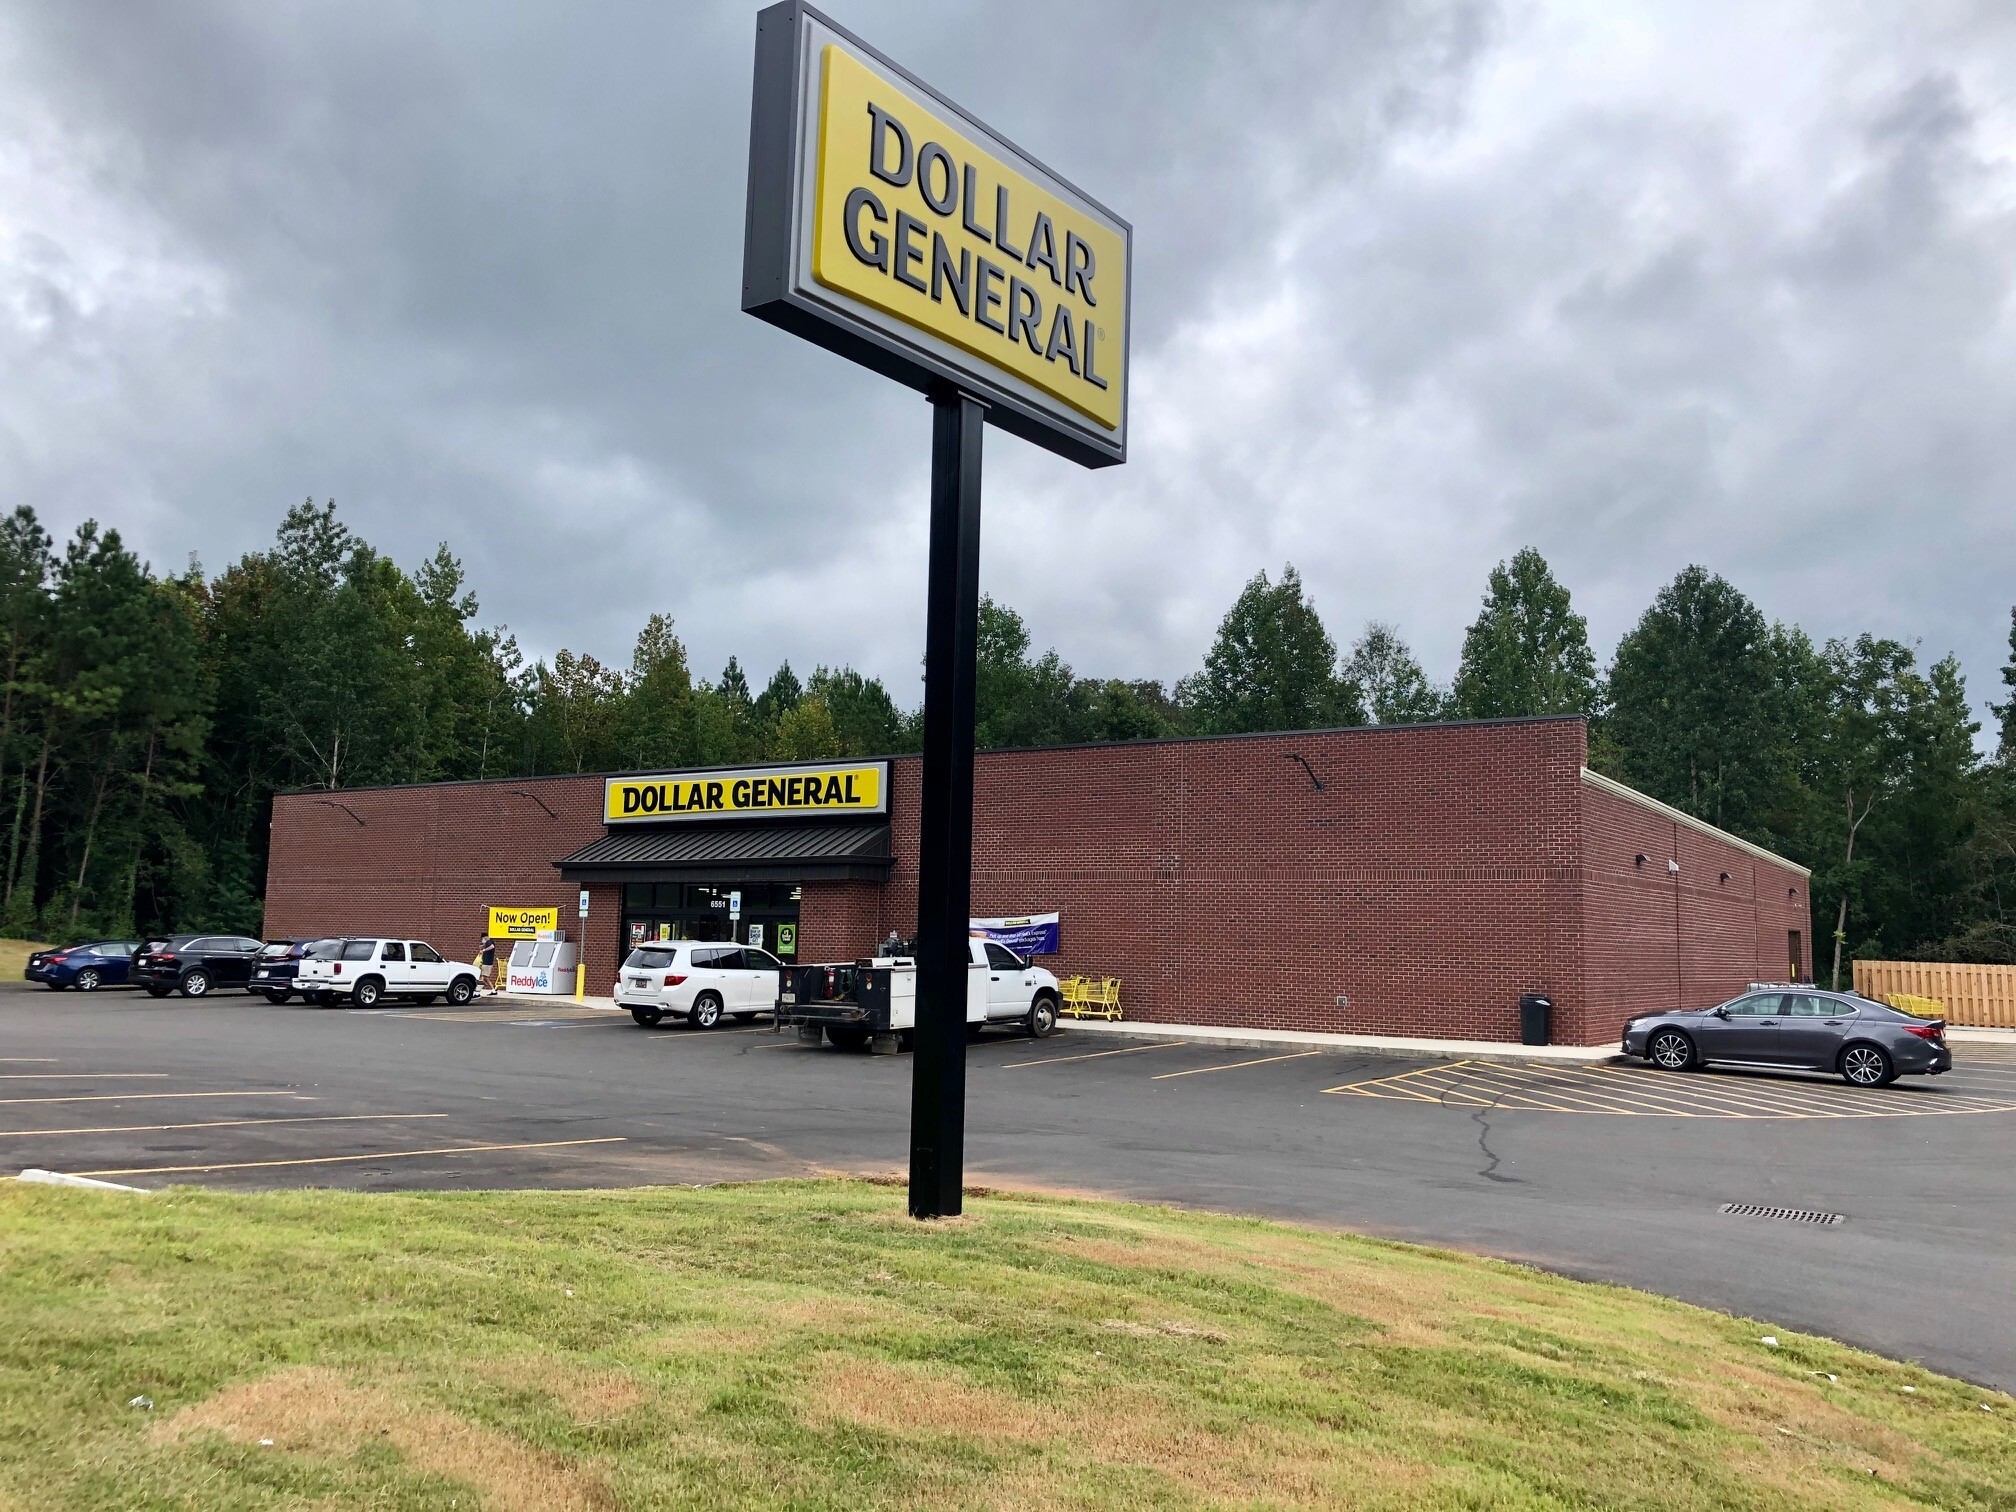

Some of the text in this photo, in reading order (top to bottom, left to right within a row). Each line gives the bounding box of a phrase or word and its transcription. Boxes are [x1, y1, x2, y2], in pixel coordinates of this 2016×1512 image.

[867, 100, 1096, 306] DOLLAR
[843, 186, 1108, 390] GENERAL
[622, 775, 861, 813] DOLLAR GENERAL
[495, 912, 550, 925] Now Open!
